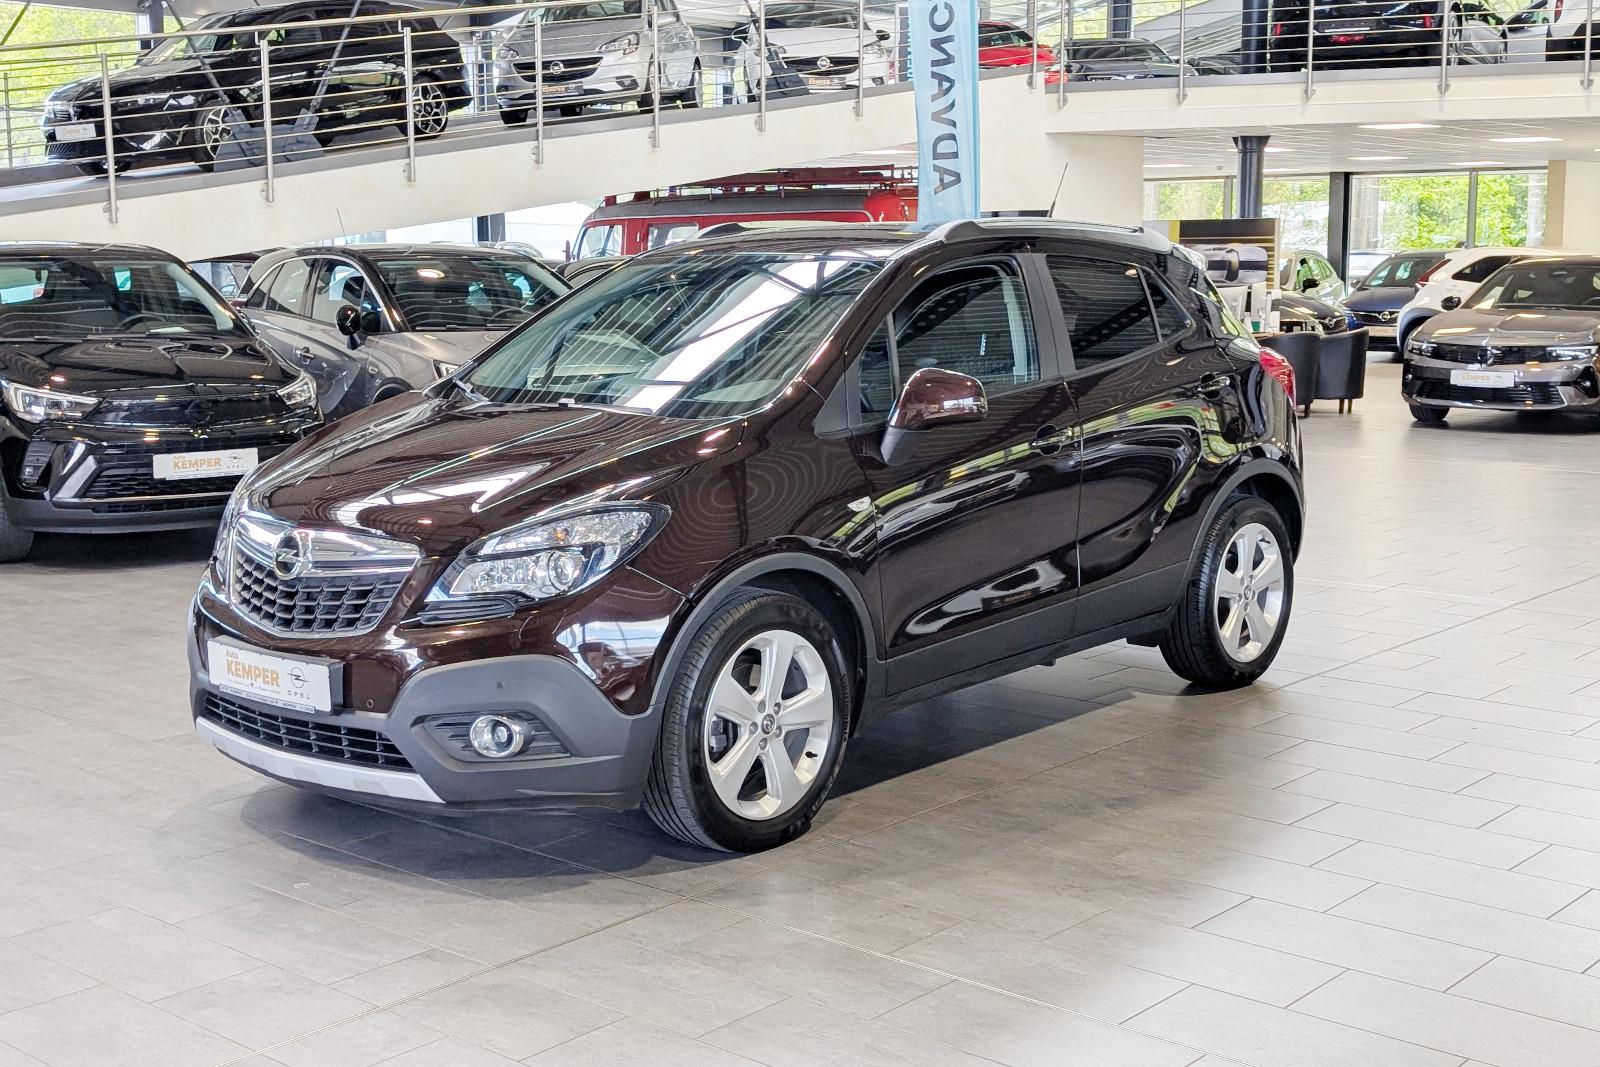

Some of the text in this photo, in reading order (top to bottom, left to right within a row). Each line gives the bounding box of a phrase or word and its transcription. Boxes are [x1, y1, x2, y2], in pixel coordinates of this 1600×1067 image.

[173, 458, 222, 470] KEMPER
[226, 659, 280, 687] KEMPER
[287, 690, 312, 700] OPEL
